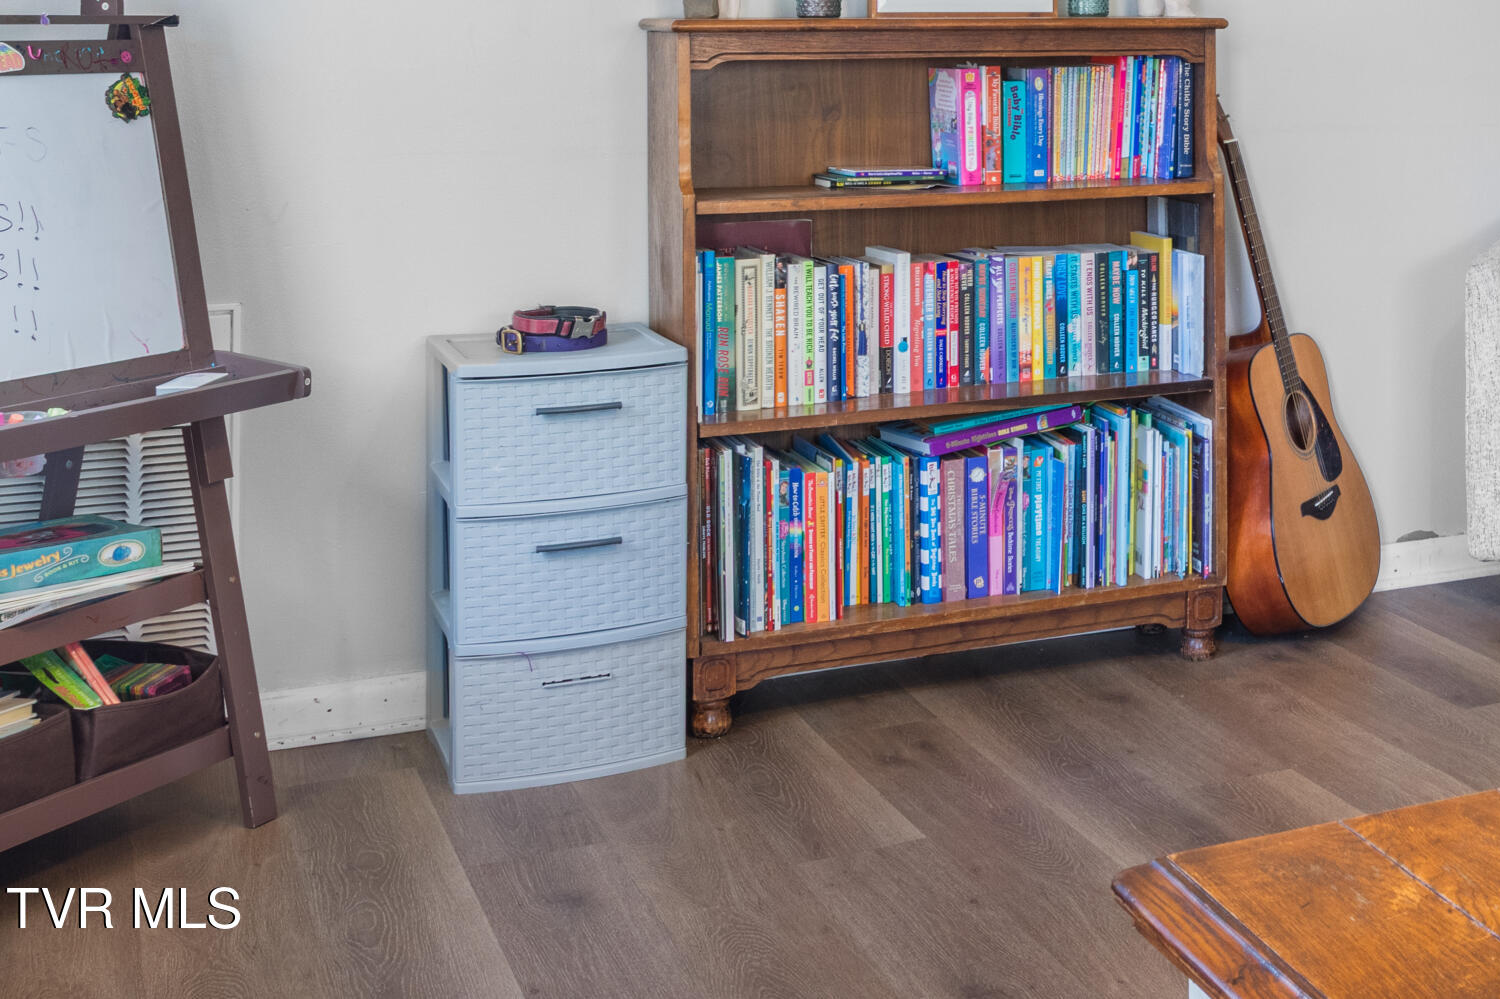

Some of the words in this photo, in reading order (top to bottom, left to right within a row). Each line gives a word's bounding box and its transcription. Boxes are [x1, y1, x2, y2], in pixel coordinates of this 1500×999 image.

[1010, 86, 1021, 111] Baby
[1010, 115, 1021, 140] Bible
[1057, 259, 1066, 280] UGLY
[1071, 264, 1079, 289] STARTS
[1112, 261, 1120, 285] MAYBE
[1141, 269, 1146, 278] TO
[1057, 283, 1066, 300] LOVE
[1071, 291, 1079, 308] WITH
[1112, 287, 1120, 304] NOW
[705, 302, 713, 331] Manual
[776, 295, 785, 336] SHAKEN
[806, 318, 813, 326] TO
[1071, 311, 1079, 319] US
[1087, 306, 1093, 316] US
[718, 326, 728, 347] RUN
[913, 320, 921, 352] Regretting
[1139, 308, 1148, 349] Mockingbird
[718, 350, 729, 373] ROSE
[913, 354, 921, 367] You
[718, 377, 728, 397] RUN
[792, 482, 800, 494] How
[792, 502, 800, 516] Catch
[947, 470, 956, 530] CHRISTMAS
[1034, 494, 1043, 536] playtime
[947, 533, 956, 563] TALES
[10, 550, 60, 578] Jewelry
